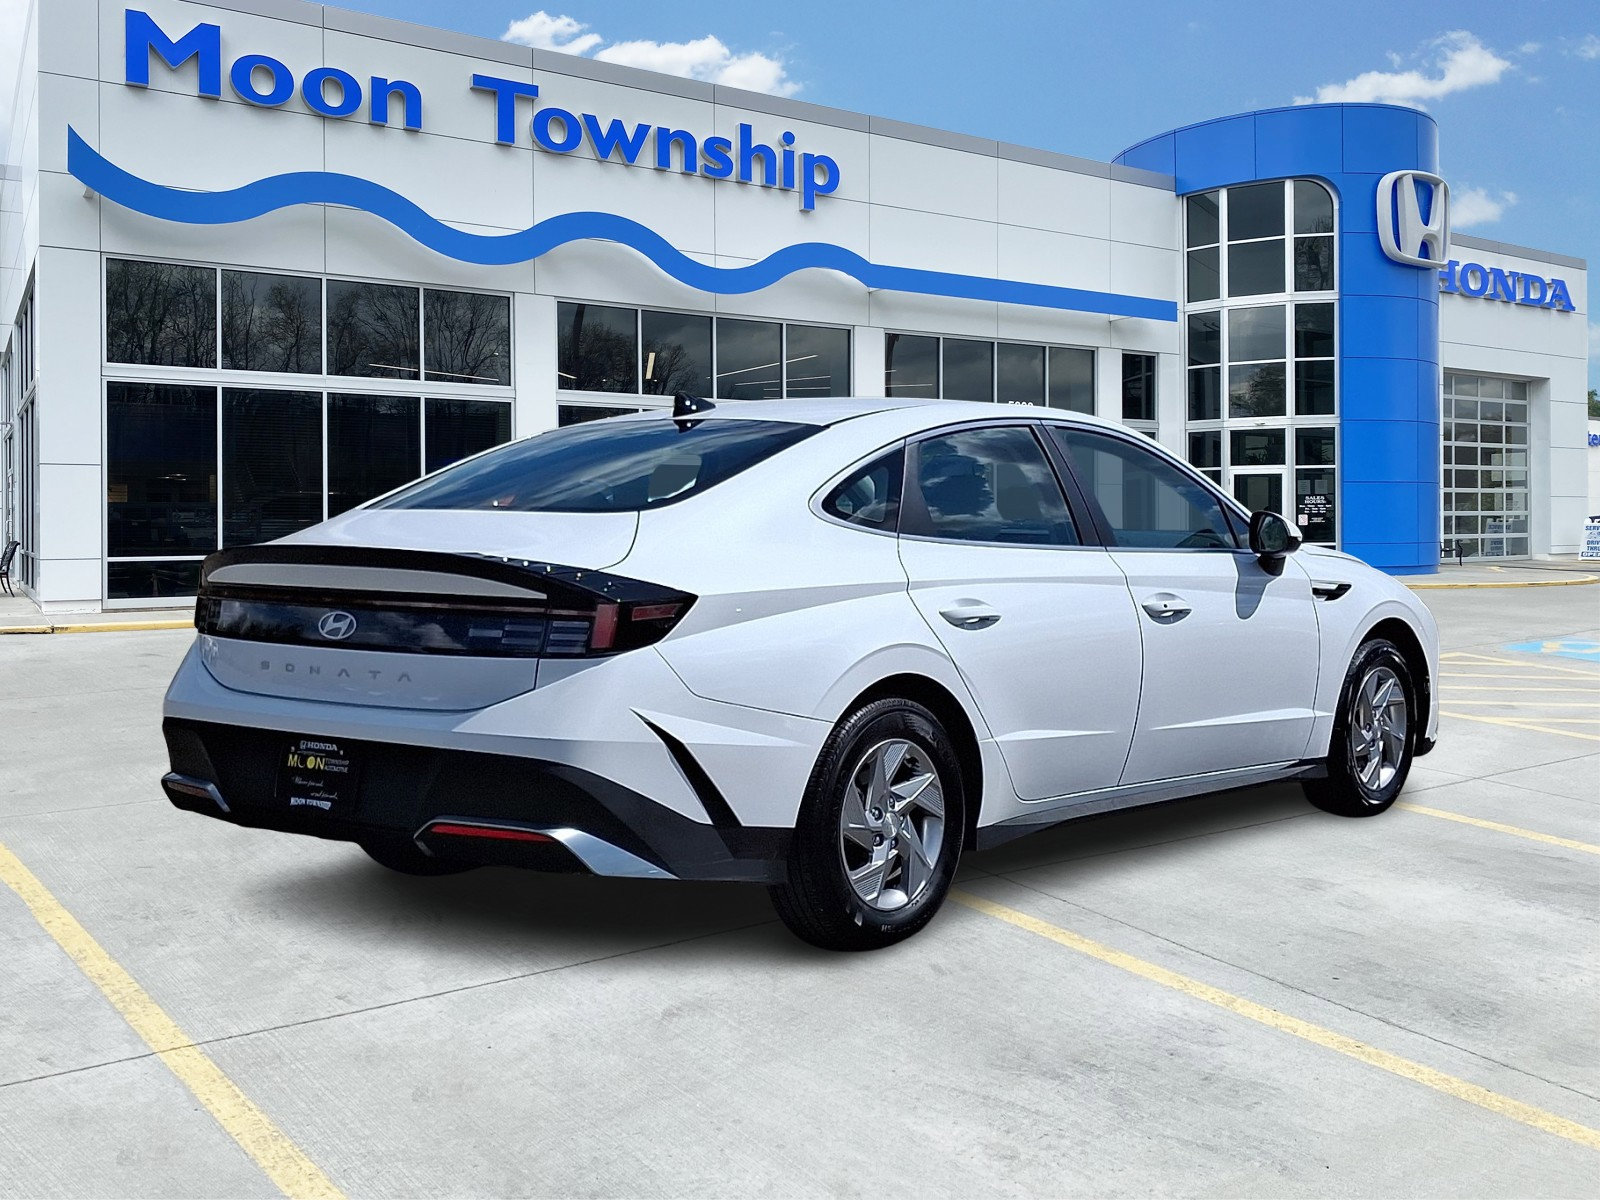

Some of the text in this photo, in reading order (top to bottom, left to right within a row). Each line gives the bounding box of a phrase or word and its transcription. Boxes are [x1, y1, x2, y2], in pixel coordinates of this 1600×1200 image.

[125, 9, 841, 212] Moon Township
[260, 660, 412, 683] SONATA
[307, 741, 338, 751] HONDA
